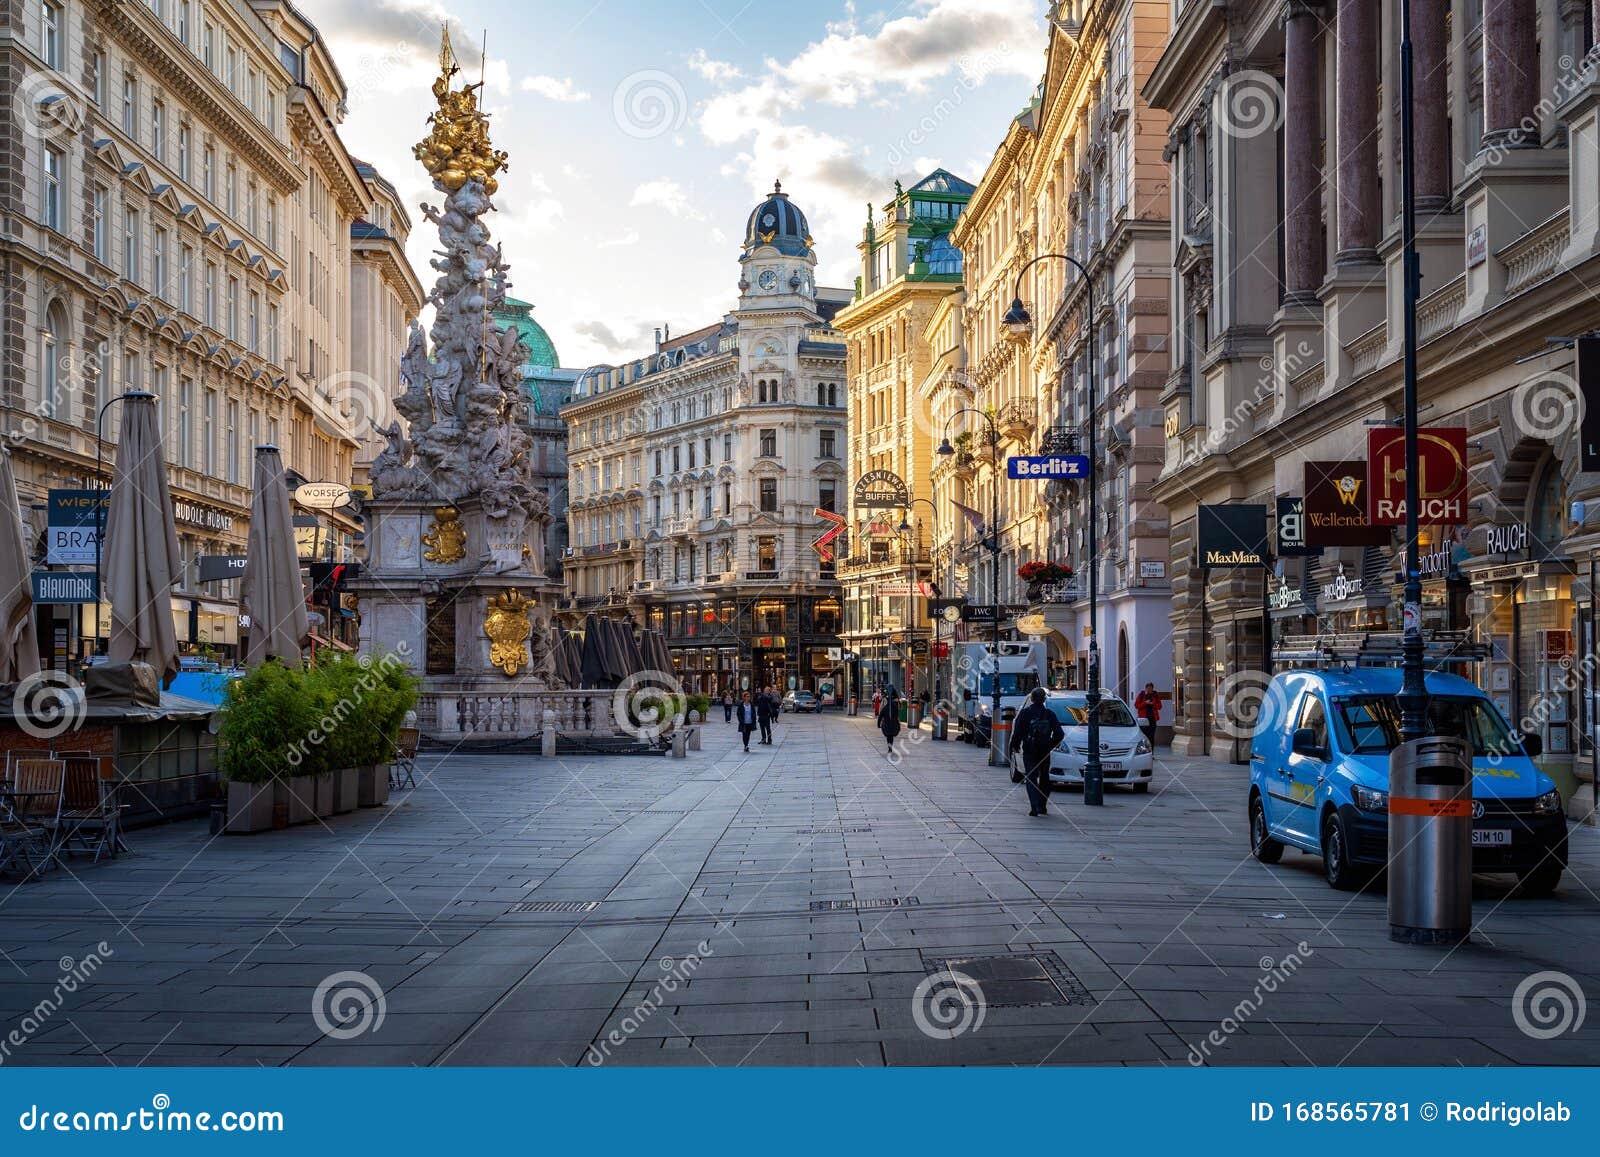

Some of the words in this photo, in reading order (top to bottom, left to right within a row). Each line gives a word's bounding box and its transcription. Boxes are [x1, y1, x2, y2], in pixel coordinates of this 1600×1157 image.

[1016, 459, 1079, 475] Berlitz
[207, 510, 233, 531] HÜBNER
[1487, 523, 1528, 556] RAUCH
[1206, 551, 1260, 564] MaxMara
[974, 608, 991, 616] IWC
[1493, 831, 1504, 843] 10
